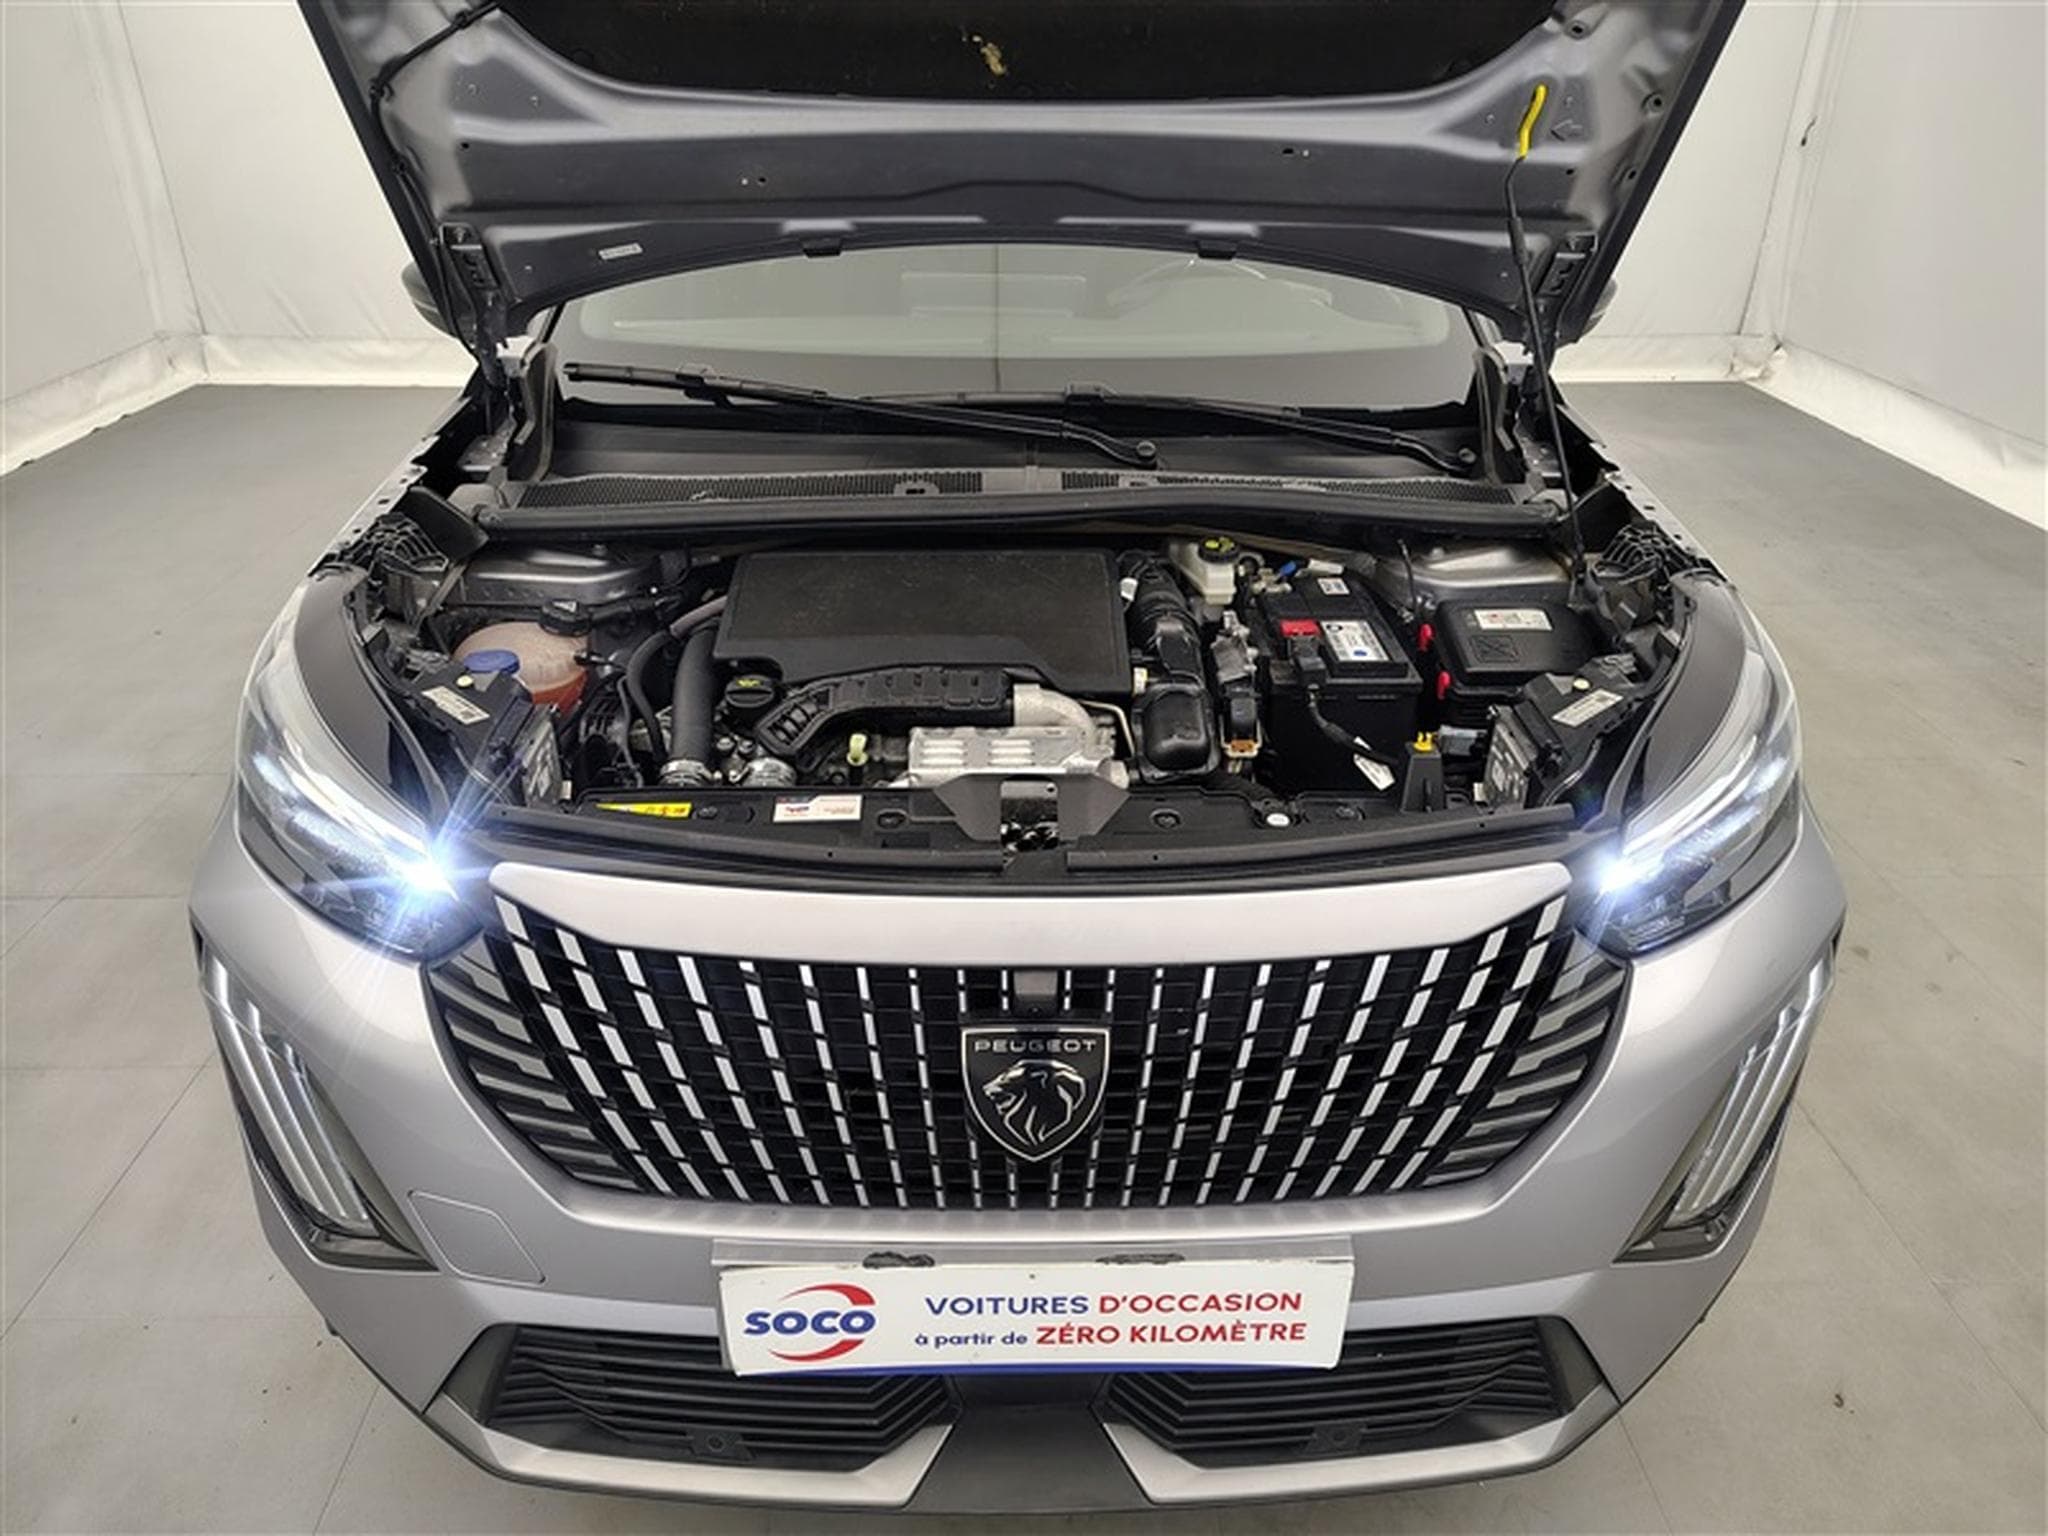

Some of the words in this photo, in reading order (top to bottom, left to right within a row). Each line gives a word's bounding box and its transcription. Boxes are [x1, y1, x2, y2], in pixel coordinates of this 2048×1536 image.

[974, 1038, 1097, 1052] PEUGEOT
[925, 1296, 1089, 1315] VOITURES
[1099, 1292, 1302, 1313] D'OCCASION
[744, 1310, 876, 1335] SOCO
[914, 1332, 928, 1346] à
[934, 1332, 995, 1349] partir
[1001, 1331, 1028, 1345] de
[1036, 1321, 1120, 1345] ZÉRO
[1130, 1318, 1308, 1343] KILOMÈTRE
